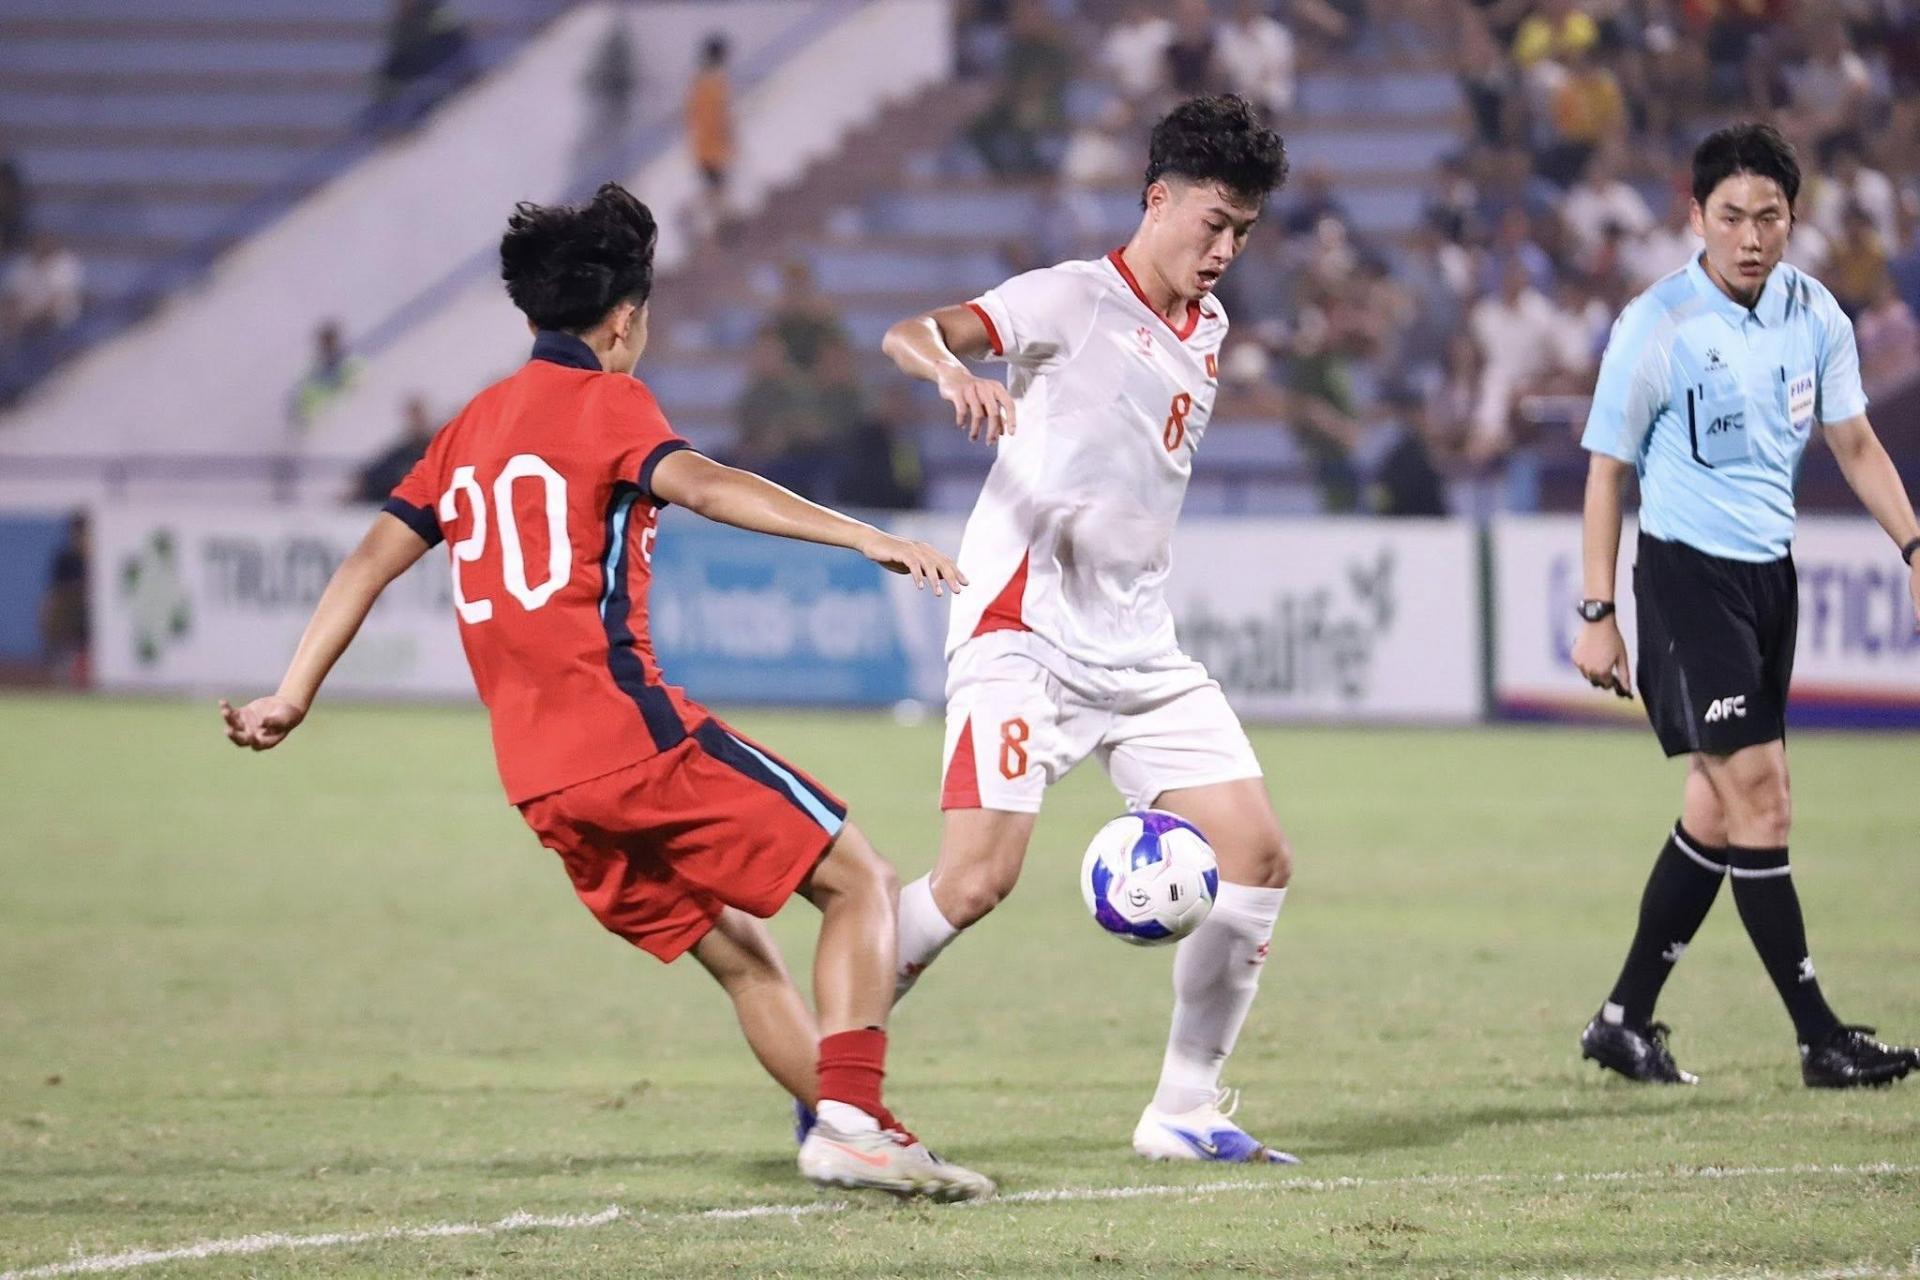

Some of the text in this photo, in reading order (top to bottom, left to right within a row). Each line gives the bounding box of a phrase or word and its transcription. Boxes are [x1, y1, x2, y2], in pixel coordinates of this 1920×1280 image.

[1791, 377, 1812, 397] FIFA
[1163, 392, 1192, 452] 8
[1706, 411, 1745, 435] AFC
[438, 454, 573, 625] 20
[1704, 694, 1747, 723] AFC
[999, 717, 1030, 780] 8
